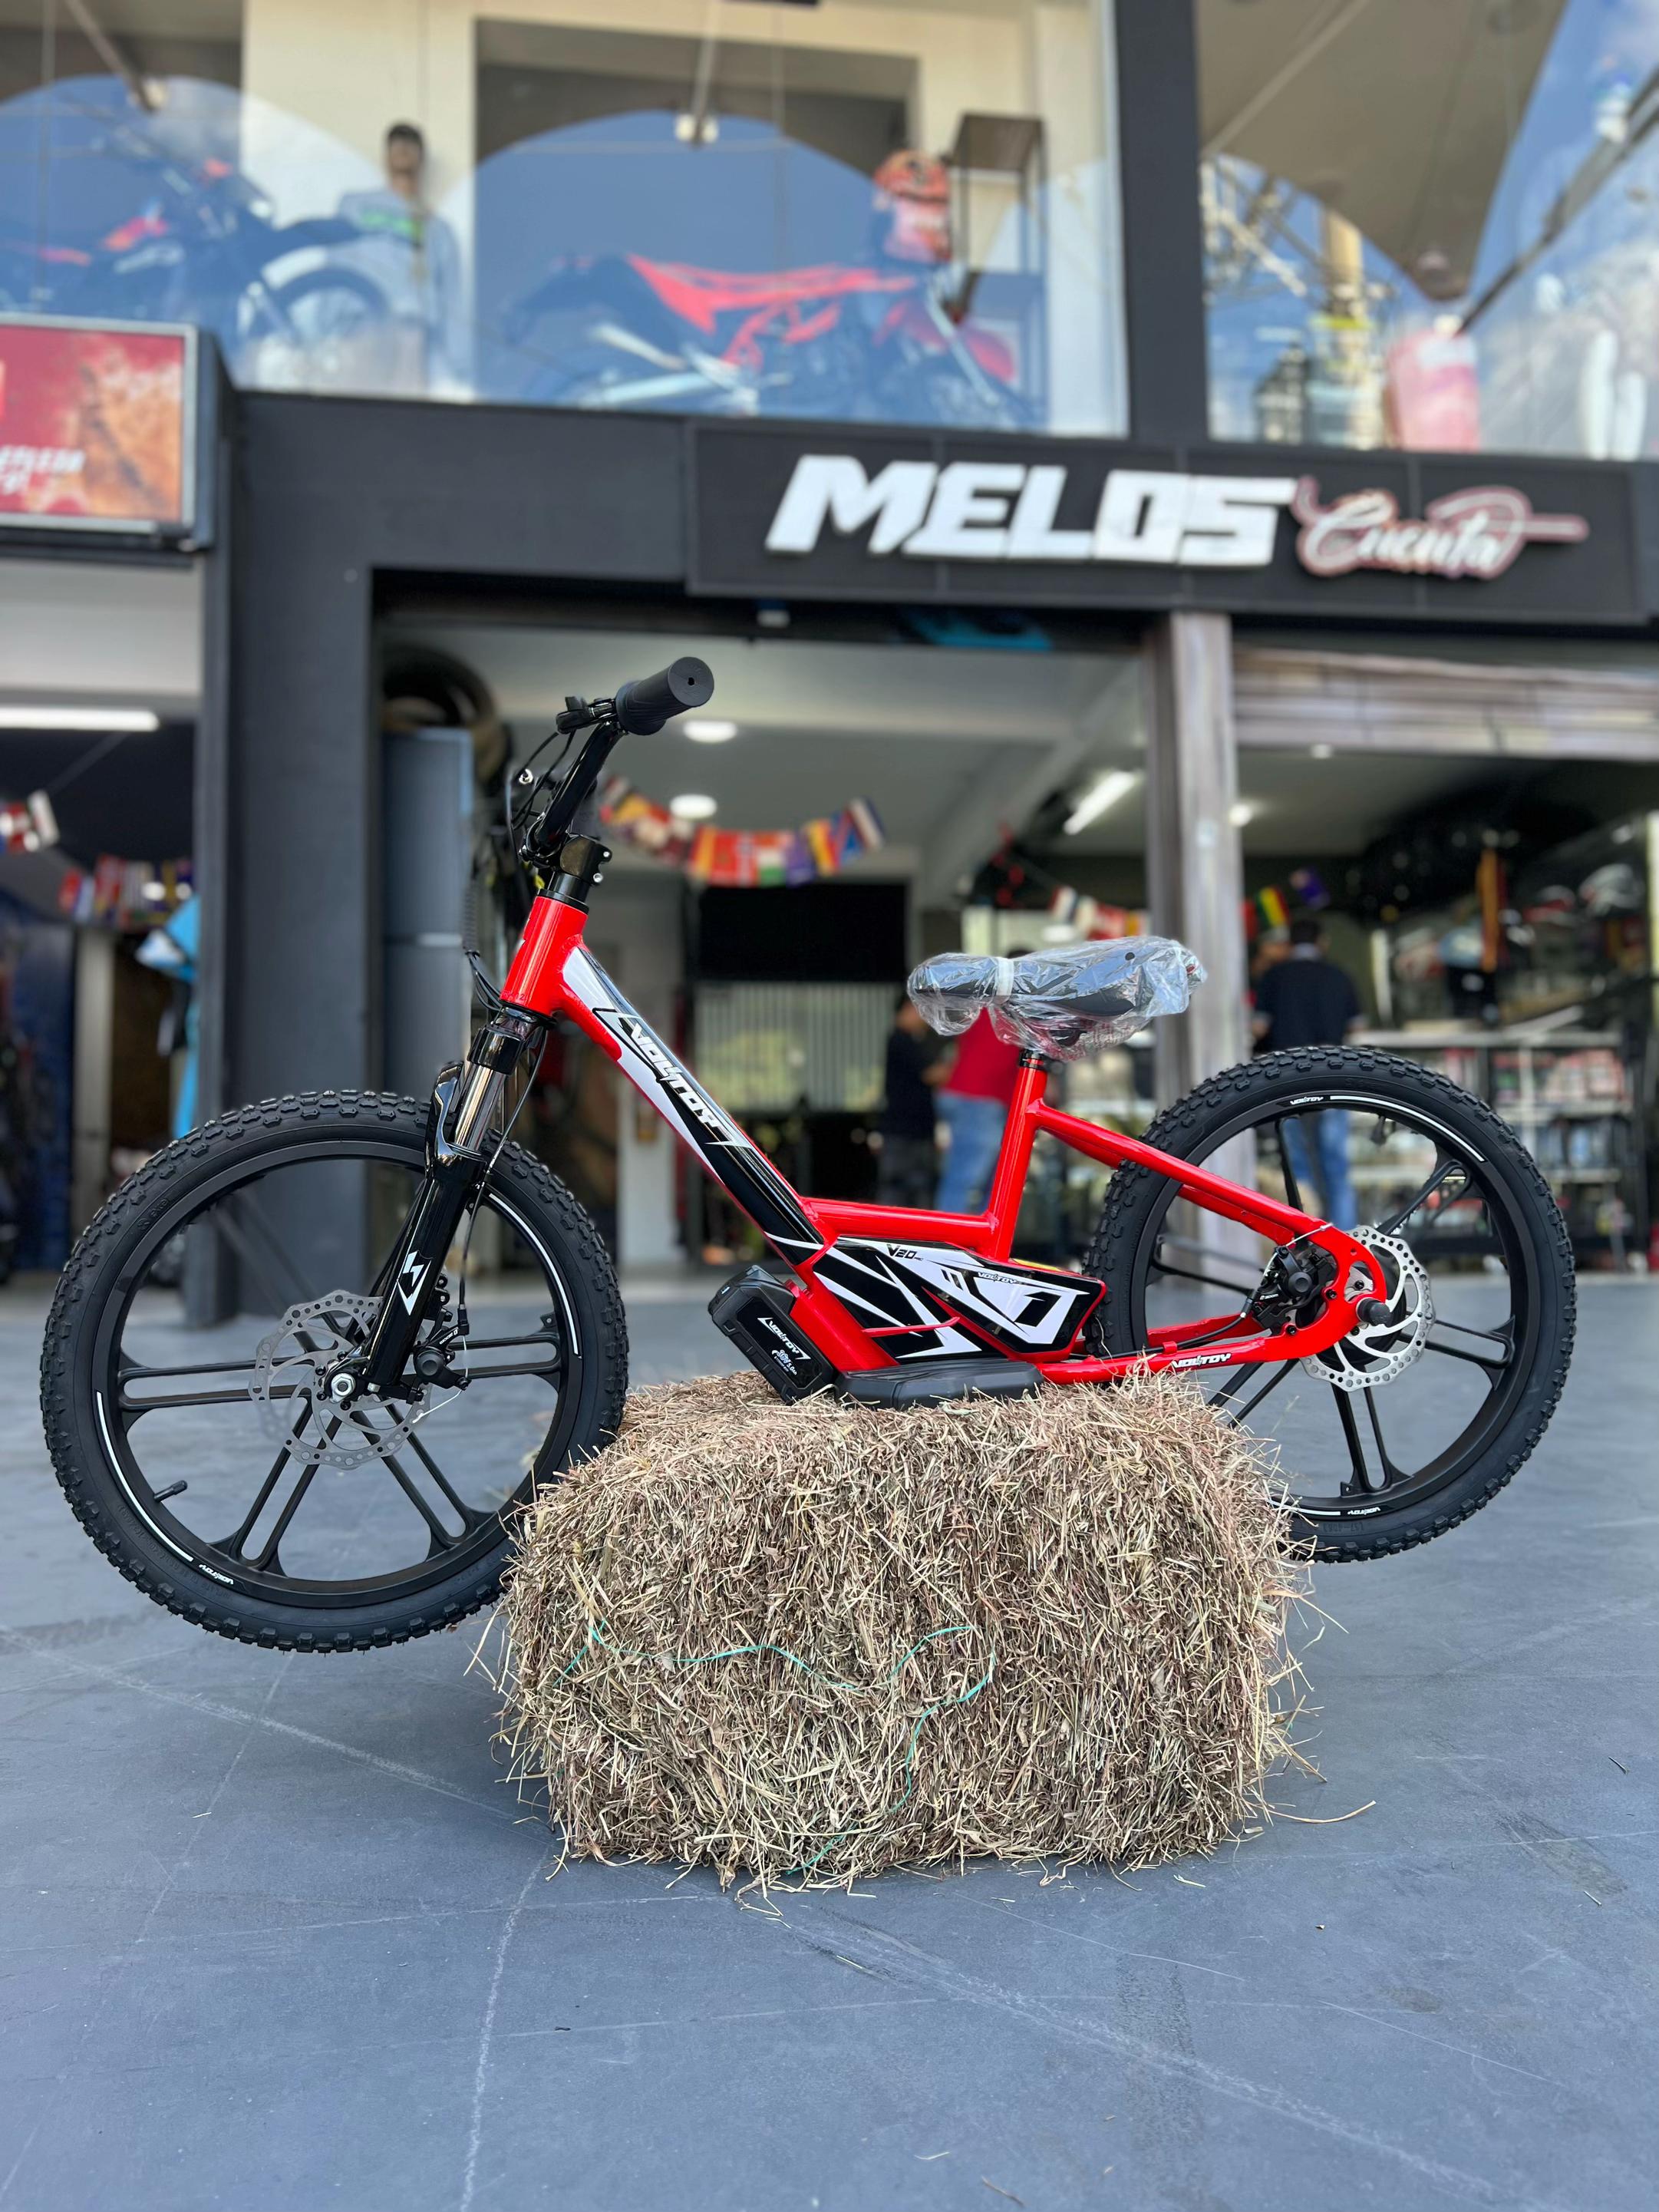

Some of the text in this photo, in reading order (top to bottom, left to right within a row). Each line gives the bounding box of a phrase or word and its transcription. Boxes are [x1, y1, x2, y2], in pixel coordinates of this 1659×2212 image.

[766, 454, 1297, 566] MELOS
[631, 1022, 722, 1127] VOLTOY
[886, 1243, 917, 1259] V20
[978, 1272, 1017, 1284] VOLTOY
[769, 1320, 800, 1354] VOLTOY
[1172, 1353, 1232, 1368] VOLTOY
